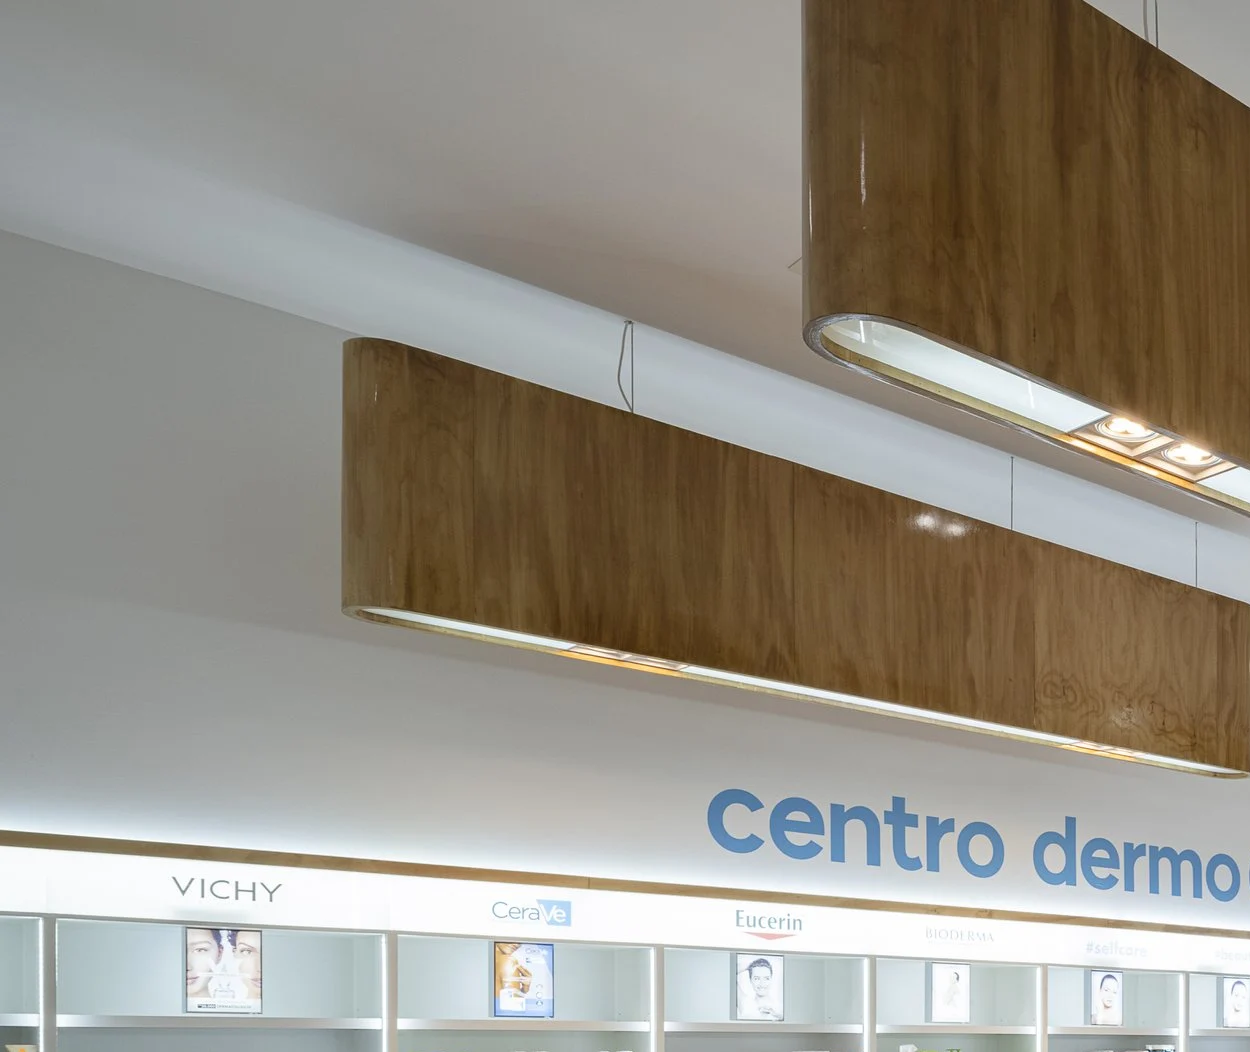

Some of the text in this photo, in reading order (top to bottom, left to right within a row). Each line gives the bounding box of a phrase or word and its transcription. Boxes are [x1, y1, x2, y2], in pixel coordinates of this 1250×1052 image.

[707, 789, 1004, 878] centro
[1033, 816, 1242, 903] dermo
[171, 876, 283, 903] VICHY
[491, 900, 567, 924] CeraVe
[735, 910, 803, 933] Eucerin
[925, 926, 995, 943] BIODERMA
[1085, 940, 1149, 957] #selfcare
